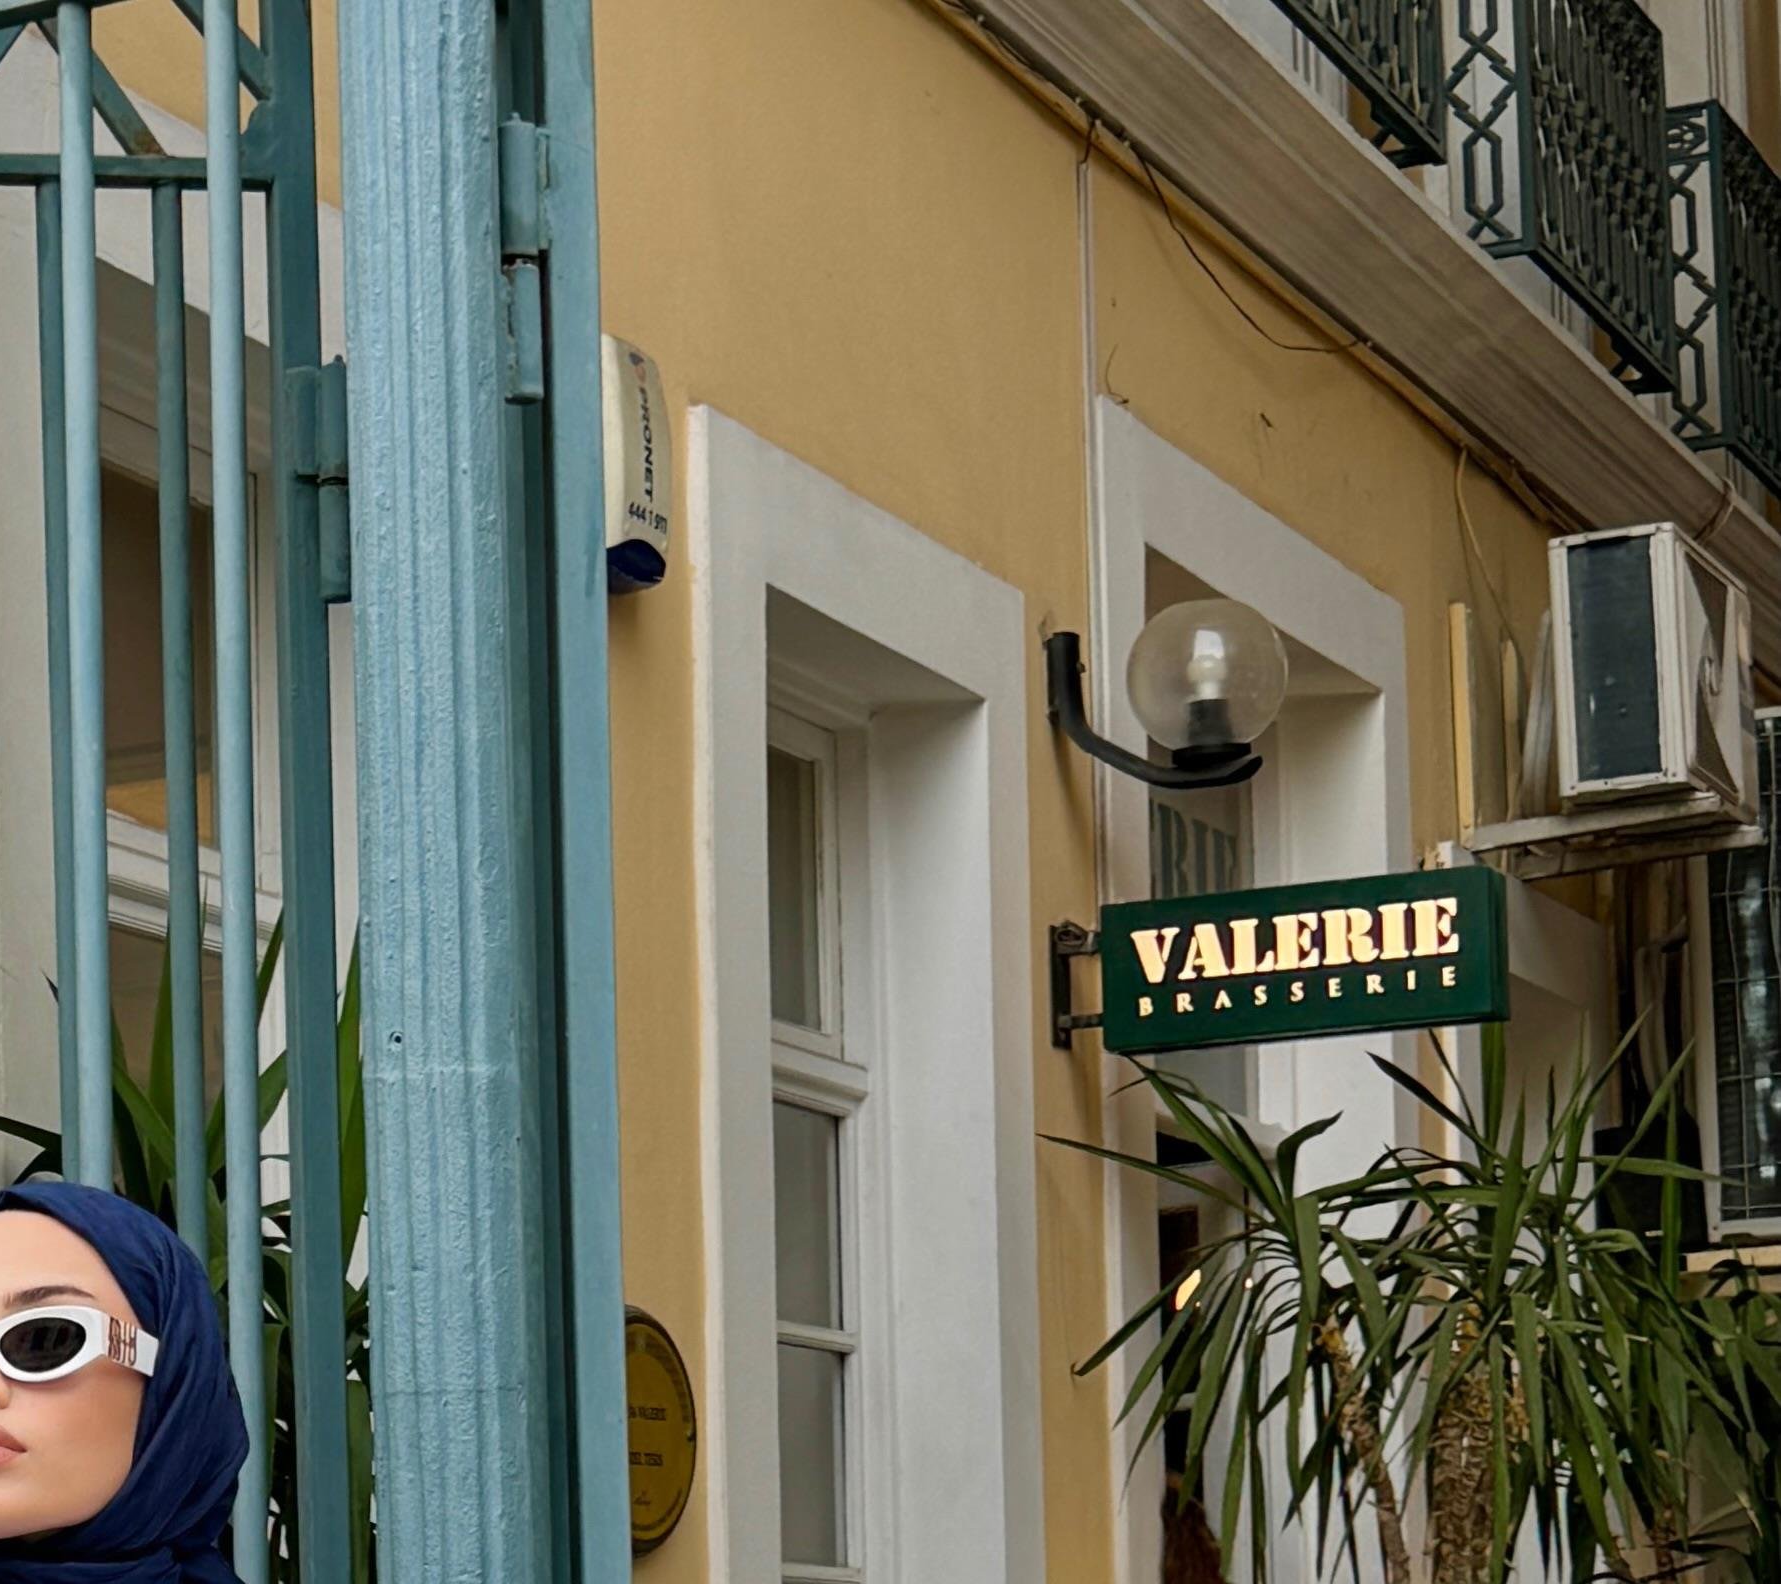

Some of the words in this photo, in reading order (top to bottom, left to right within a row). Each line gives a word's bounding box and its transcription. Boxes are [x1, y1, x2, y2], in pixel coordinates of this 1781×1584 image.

[638, 387, 654, 504] PRONET
[628, 501, 647, 521] 444
[1129, 897, 1460, 984] VALERIE
[1137, 965, 1458, 1017] BRASSERIE
